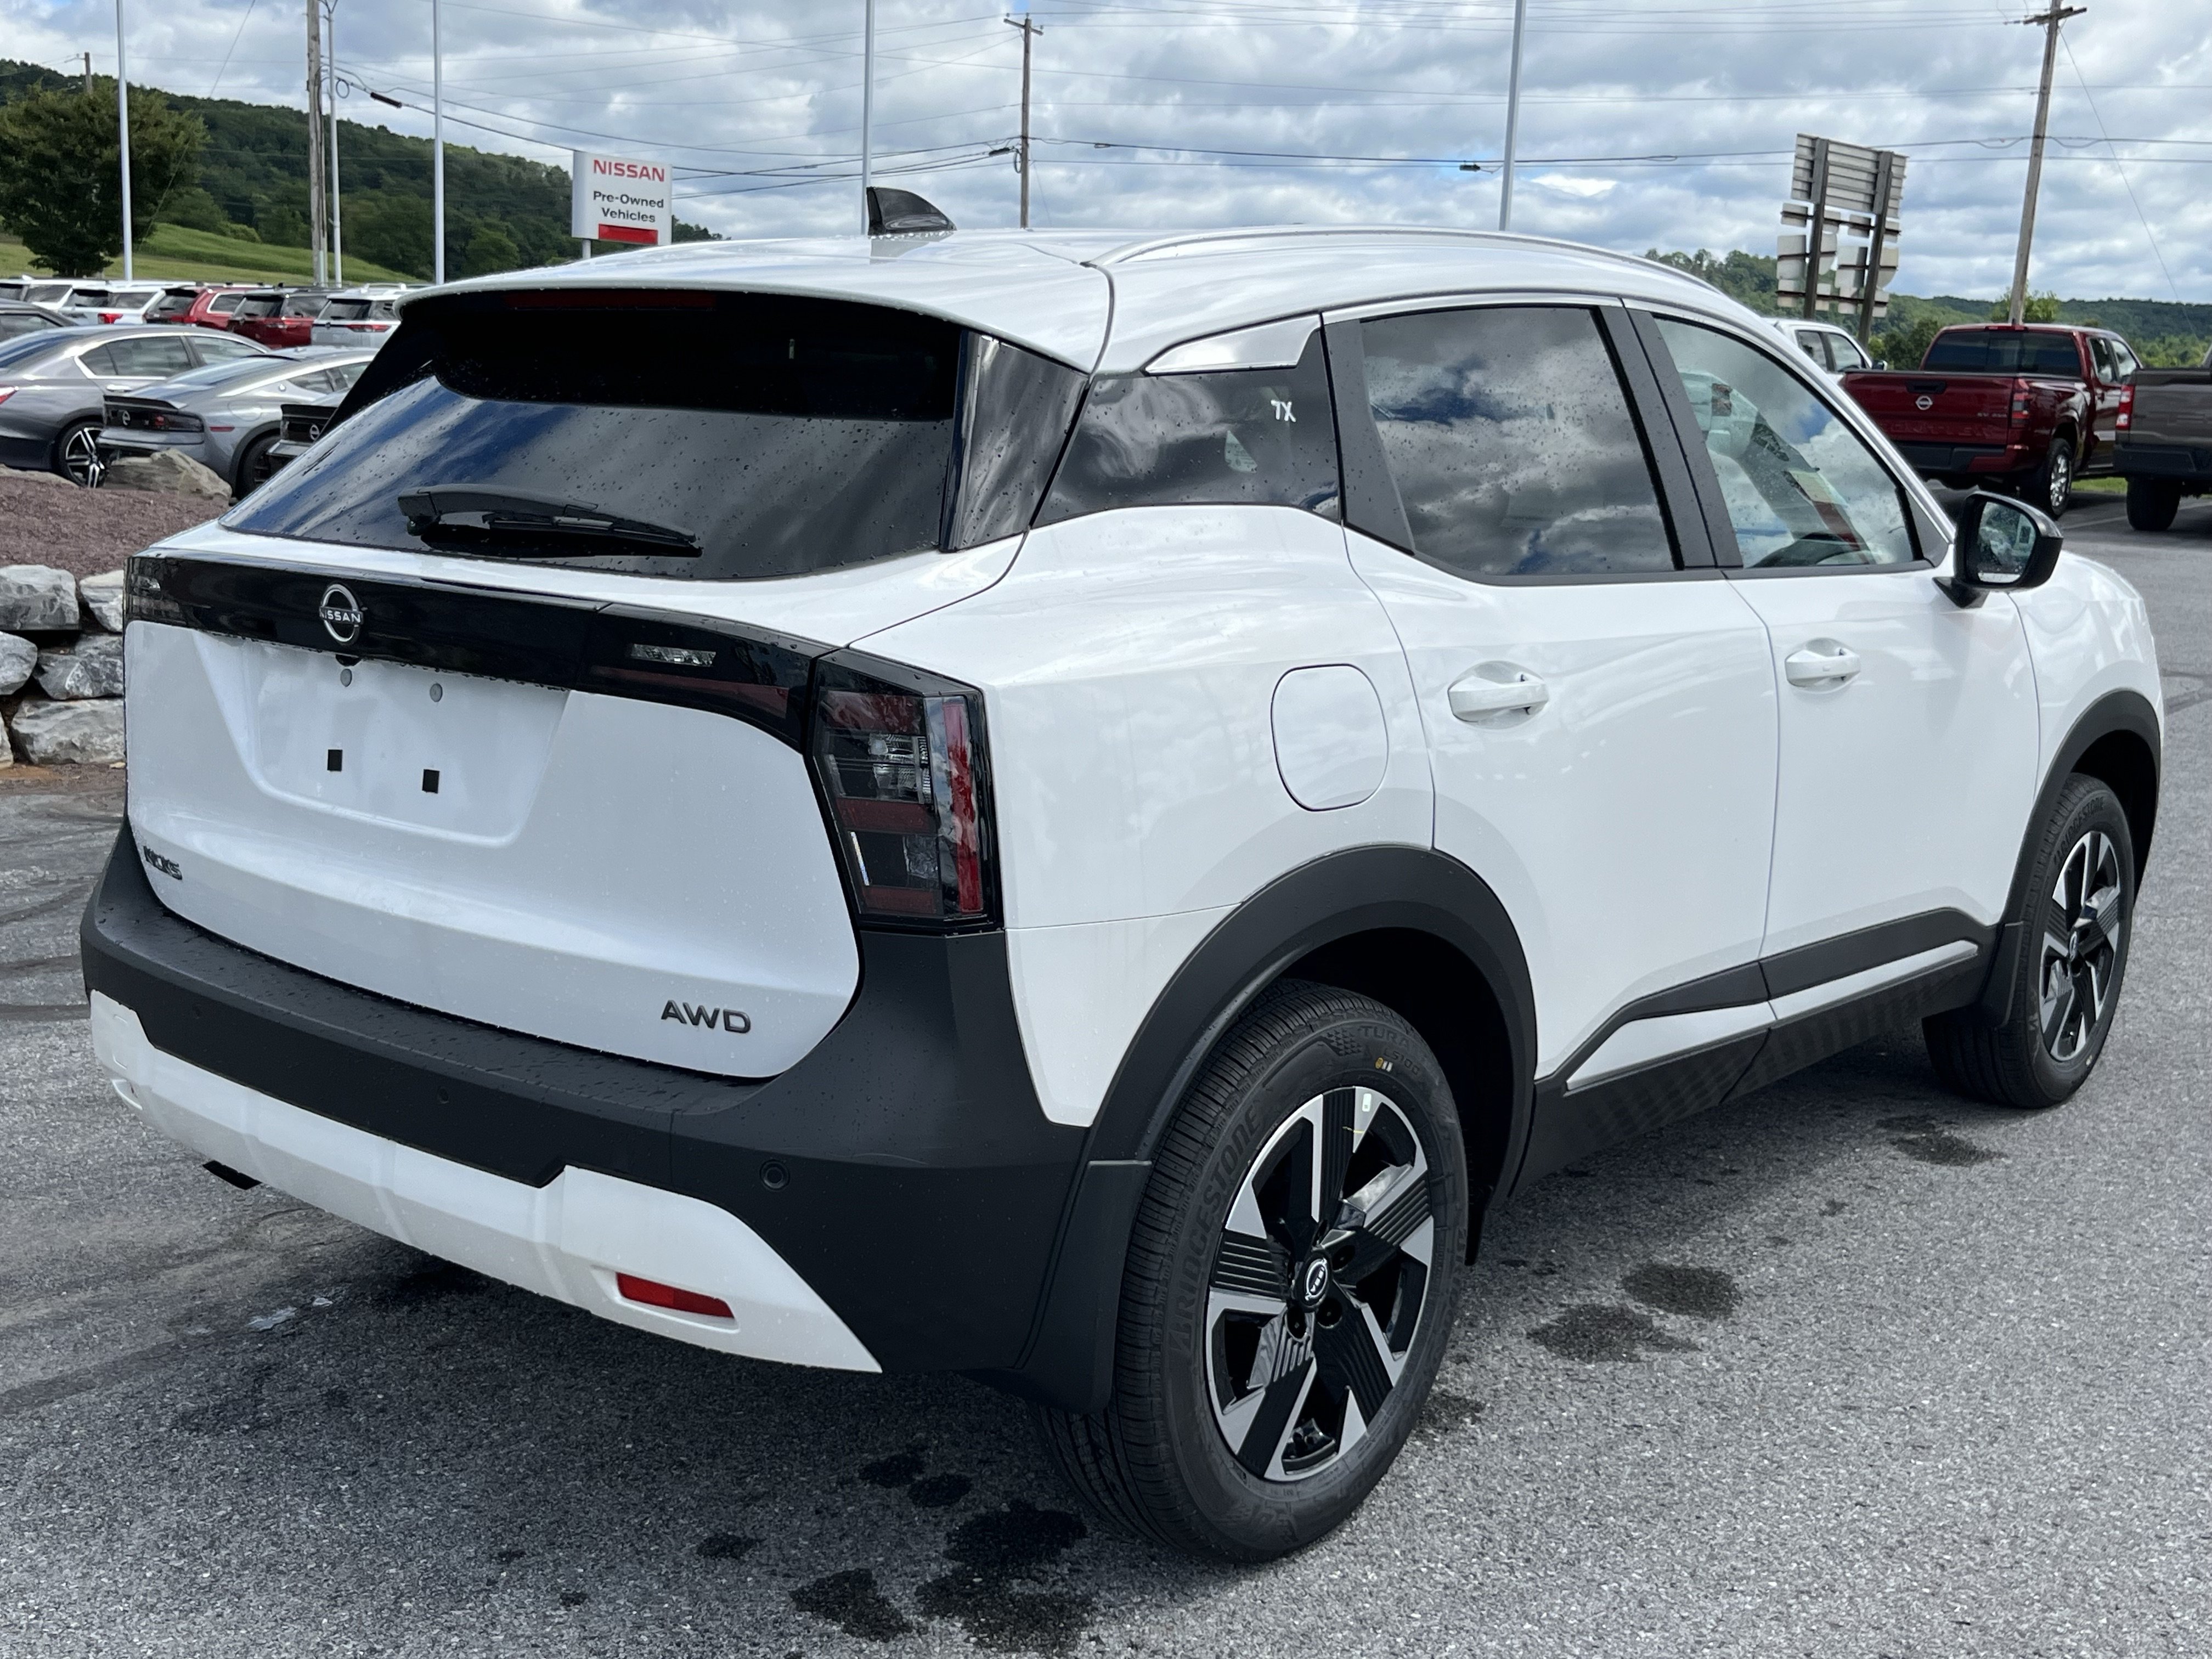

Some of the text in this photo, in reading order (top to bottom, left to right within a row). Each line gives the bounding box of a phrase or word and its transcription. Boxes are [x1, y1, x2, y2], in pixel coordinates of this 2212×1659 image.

[593, 159, 665, 182] NISSAN
[593, 190, 664, 208] Pre-Owned
[602, 207, 656, 222] Vehicles
[661, 1000, 751, 1034] AWD
[1168, 1103, 1261, 1351] BRIDGESTONE
